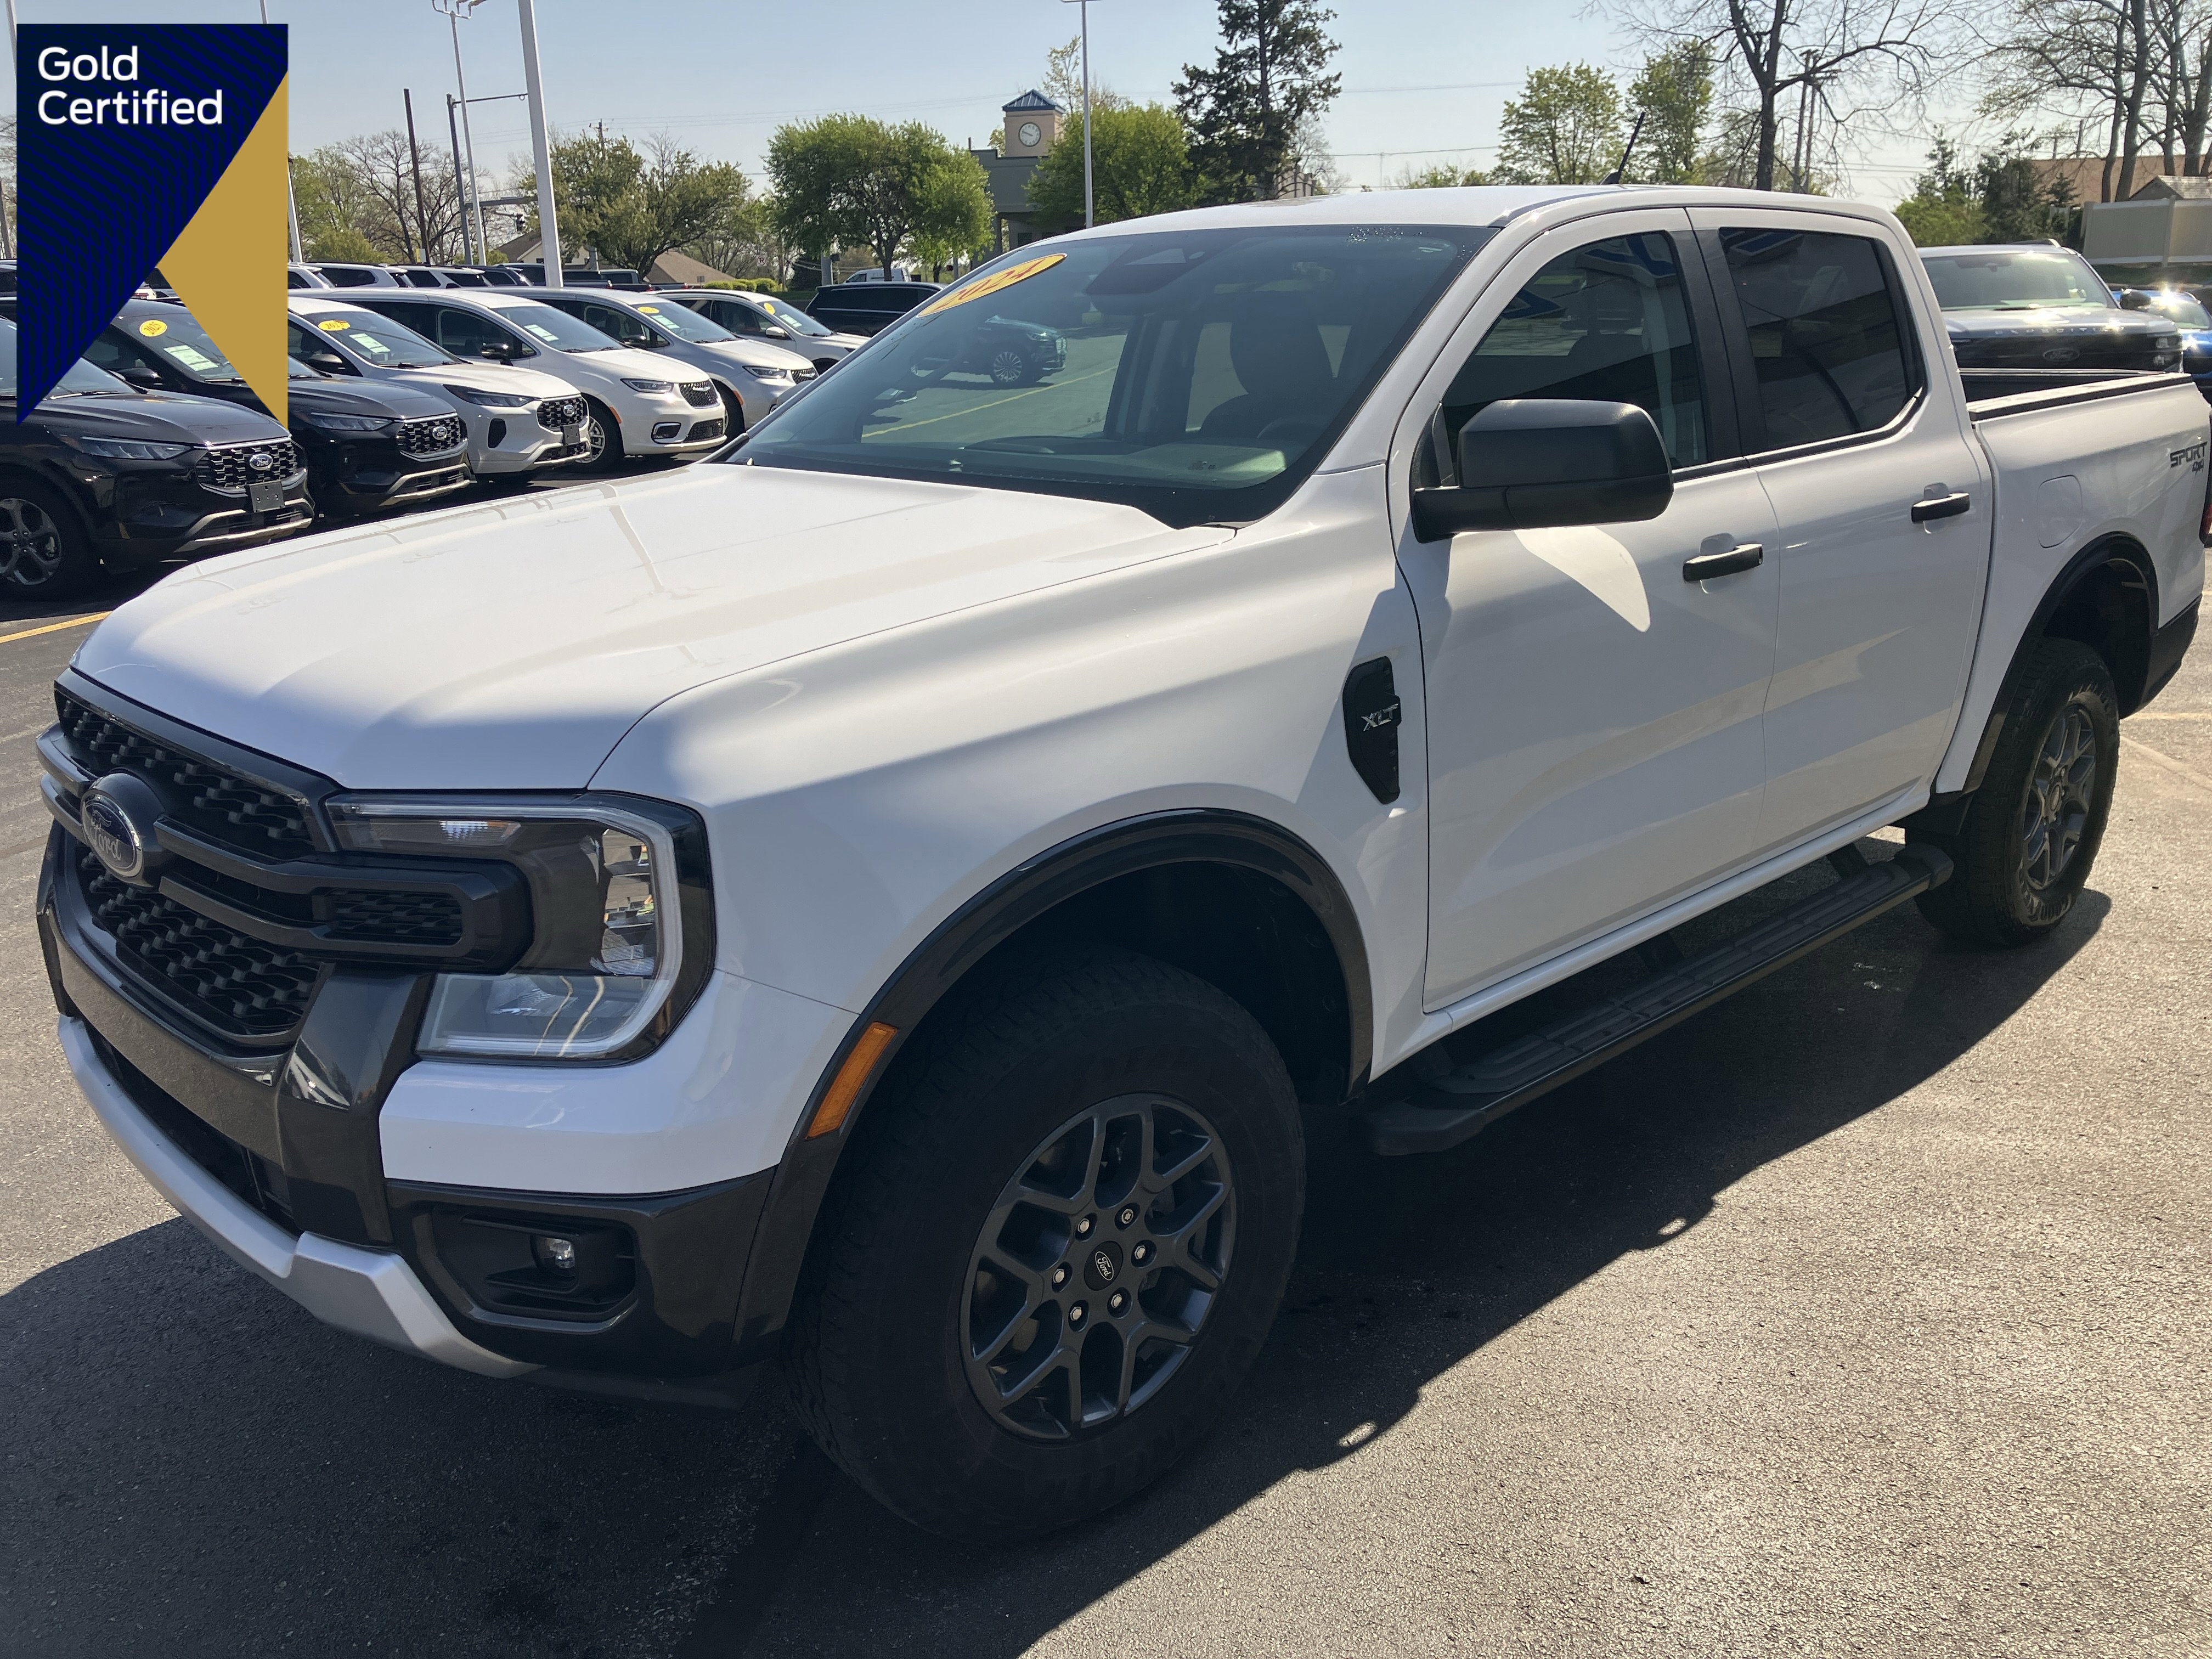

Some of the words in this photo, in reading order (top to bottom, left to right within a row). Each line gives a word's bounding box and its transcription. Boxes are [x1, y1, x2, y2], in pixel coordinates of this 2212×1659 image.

[933, 257, 1047, 311] 2024
[2170, 441, 2208, 469] SPORT
[1361, 703, 1398, 731] XLT
[90, 810, 122, 861] Ford
[1097, 1257, 1111, 1277] Ford
